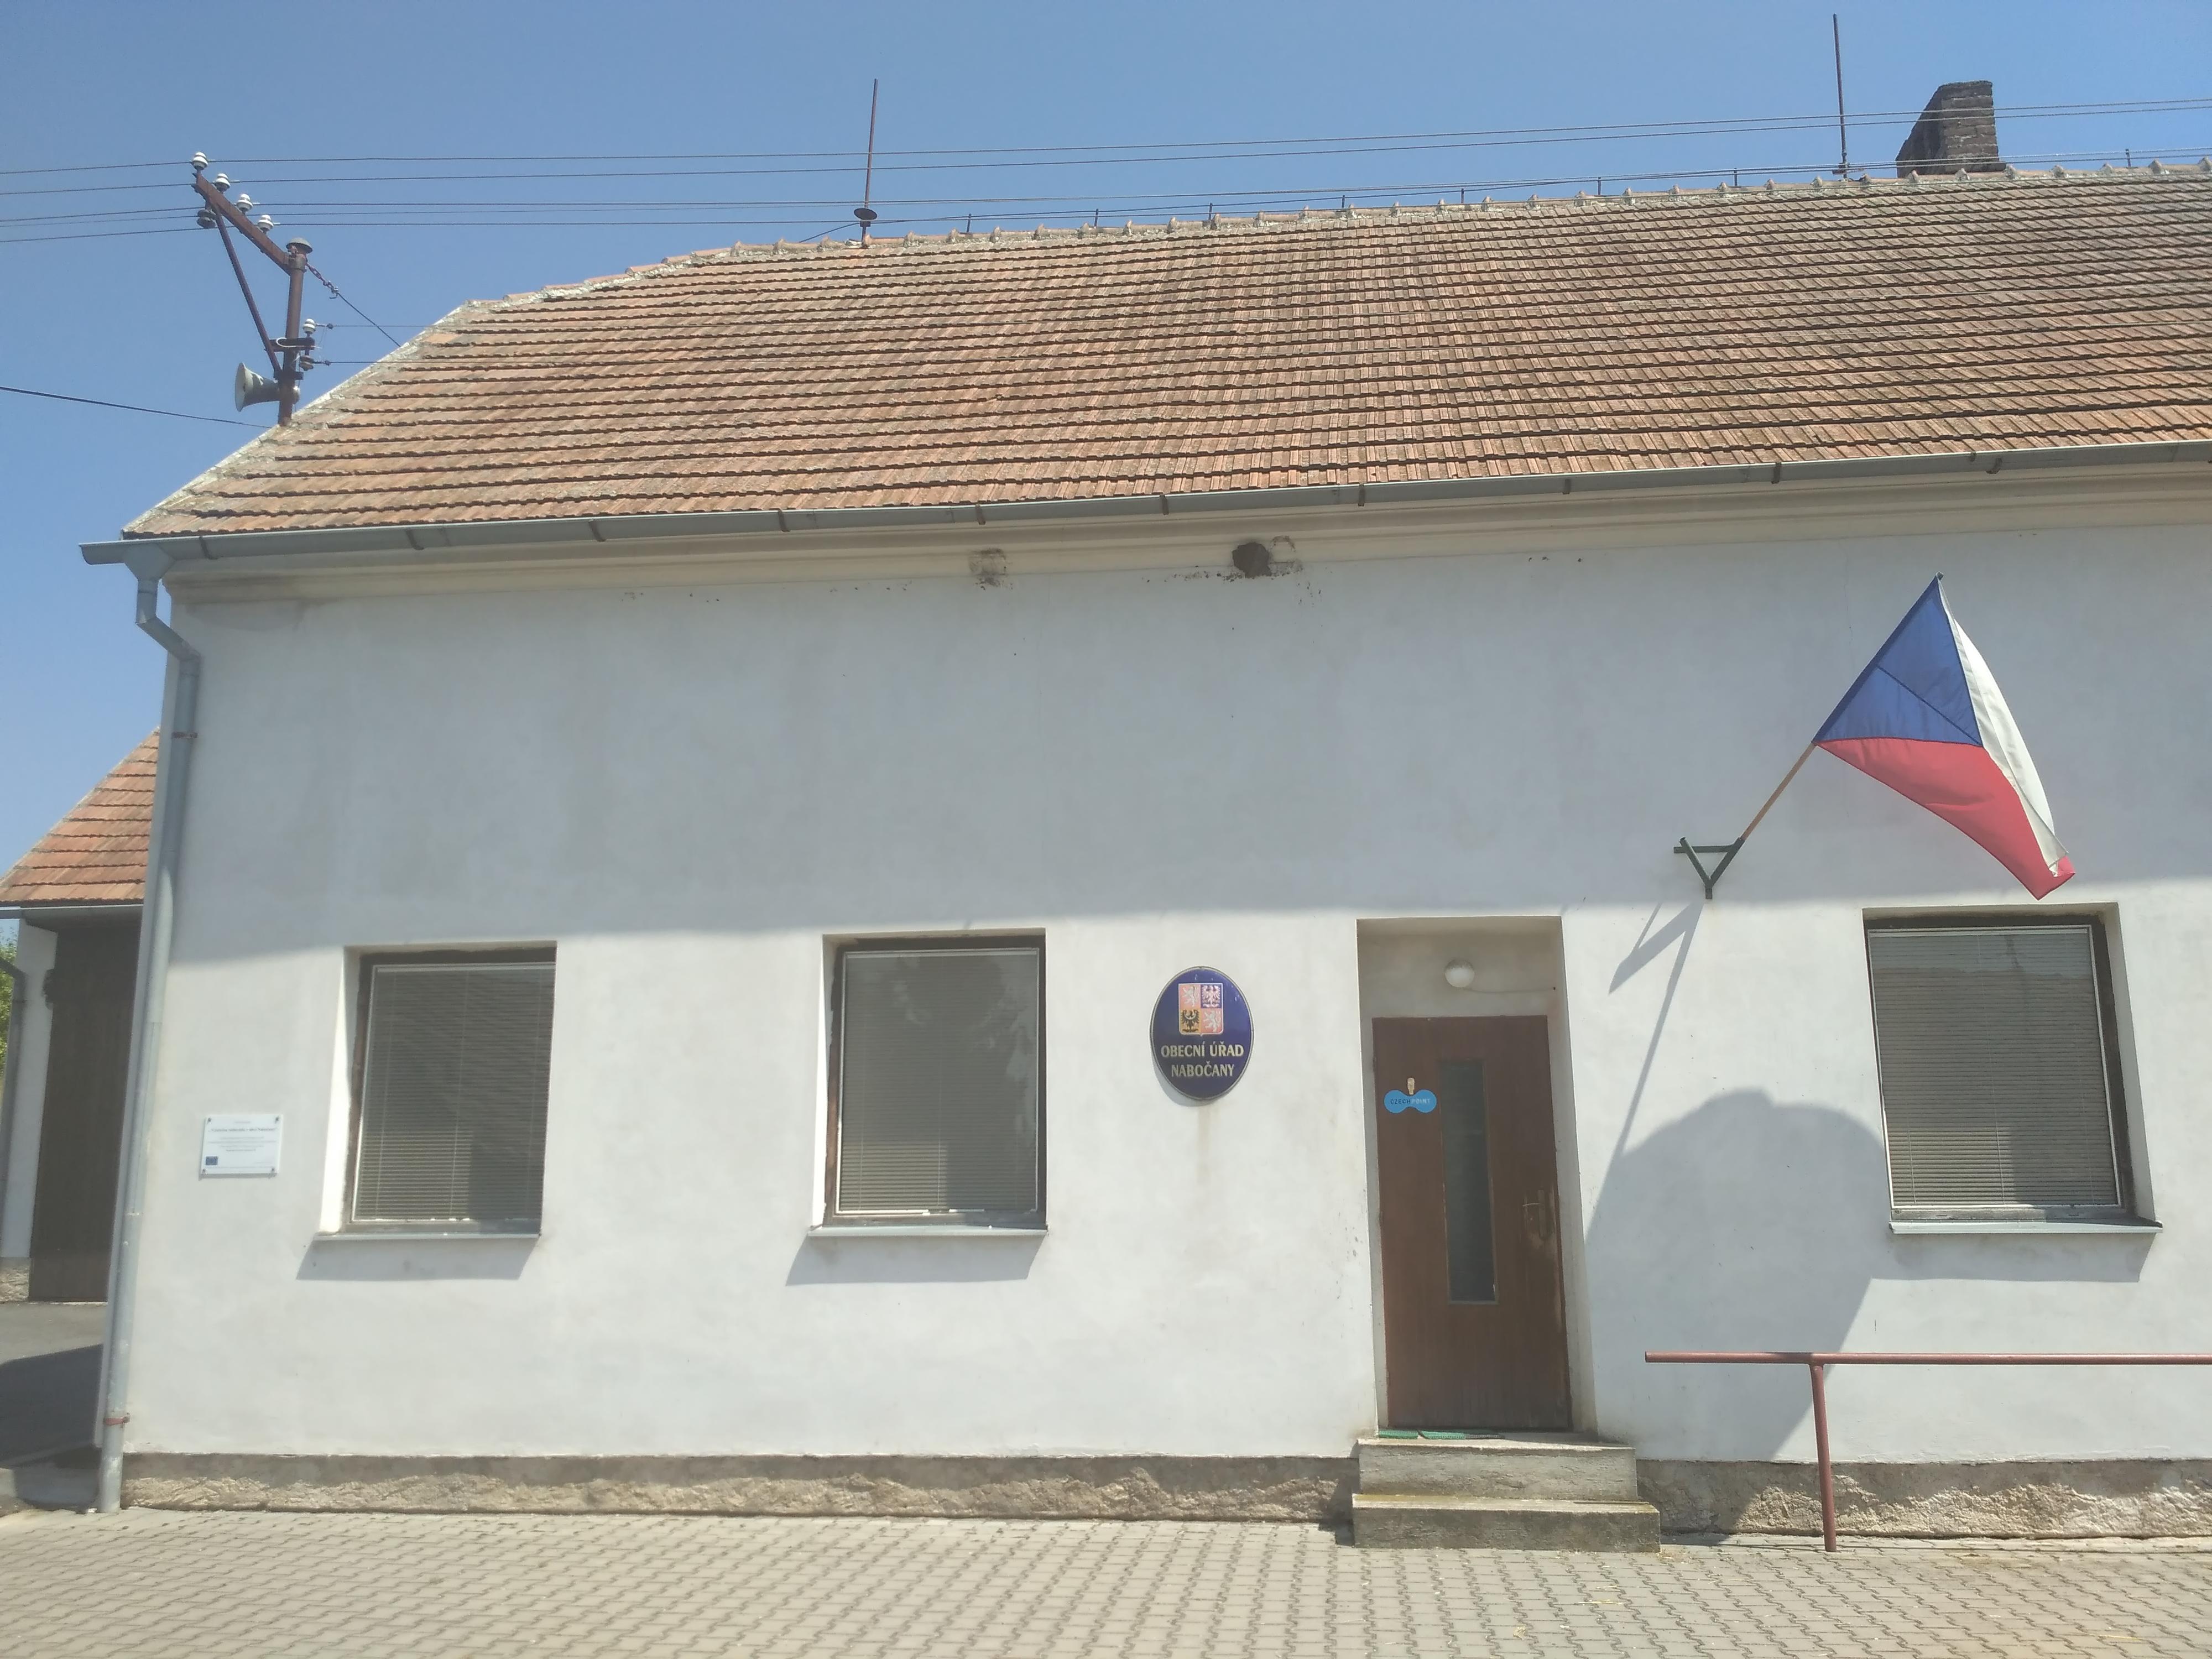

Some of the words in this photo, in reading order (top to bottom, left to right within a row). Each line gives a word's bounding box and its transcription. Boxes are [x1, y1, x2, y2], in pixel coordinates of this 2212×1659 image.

[1161, 1041, 1206, 1057] OBECNÍ
[1209, 1040, 1244, 1057] ÚŘAD
[1171, 1060, 1235, 1077] NABOČANY
